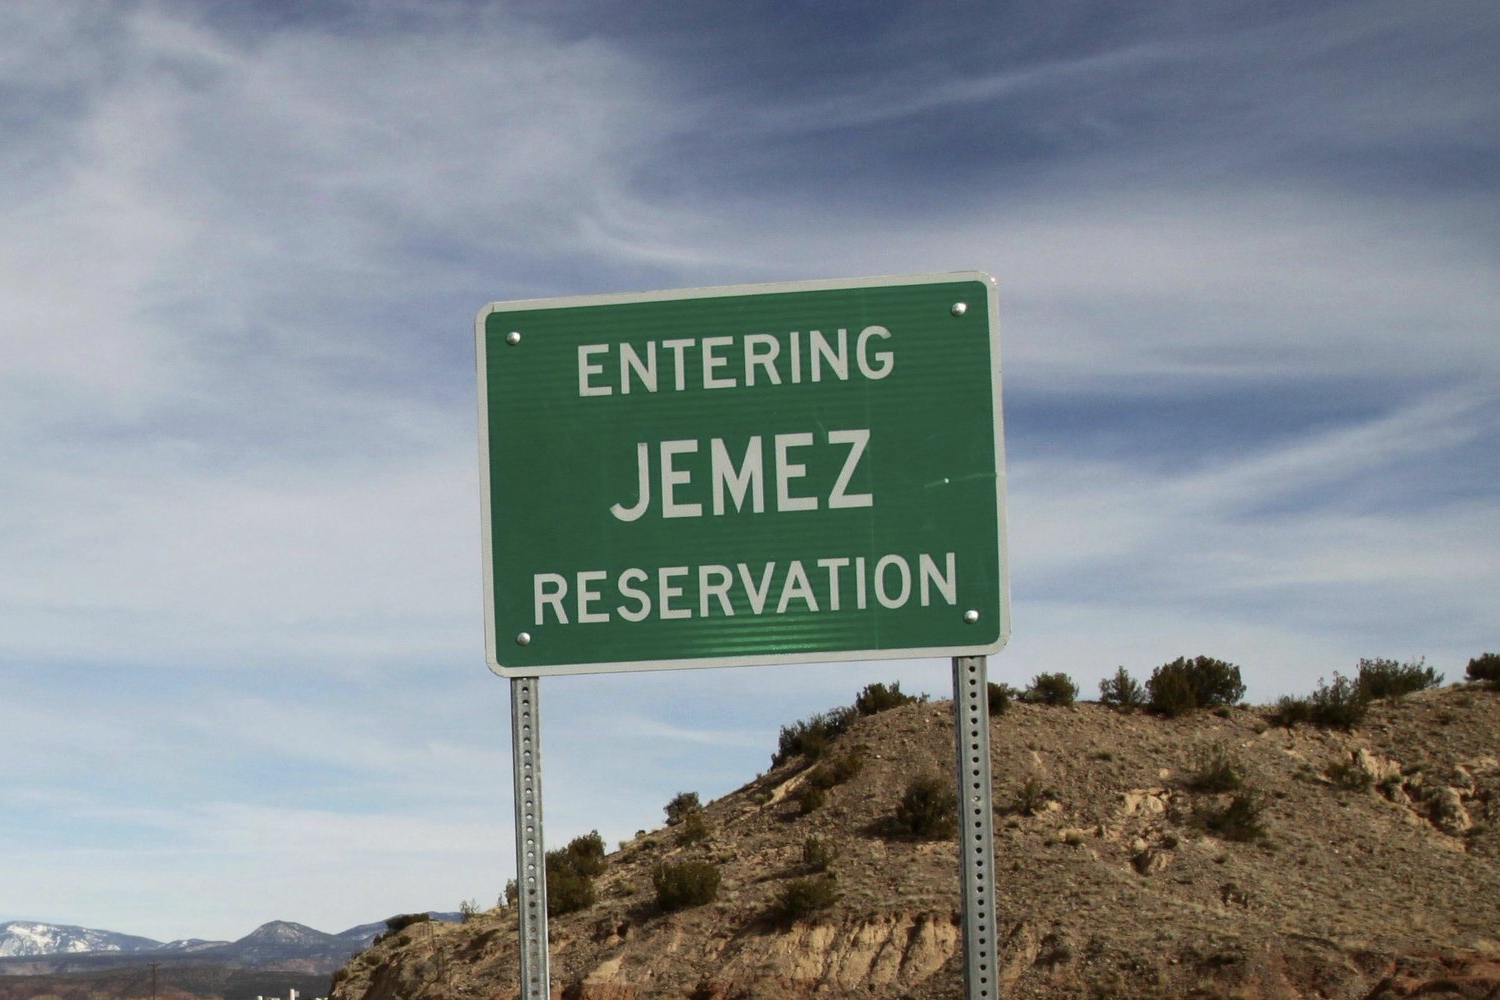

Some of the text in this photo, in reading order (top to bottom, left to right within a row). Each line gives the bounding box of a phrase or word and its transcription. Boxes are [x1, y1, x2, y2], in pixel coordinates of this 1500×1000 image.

[578, 326, 894, 397] ENTERING
[609, 429, 874, 522] JEMEZ
[533, 552, 957, 626] RESERVATION
